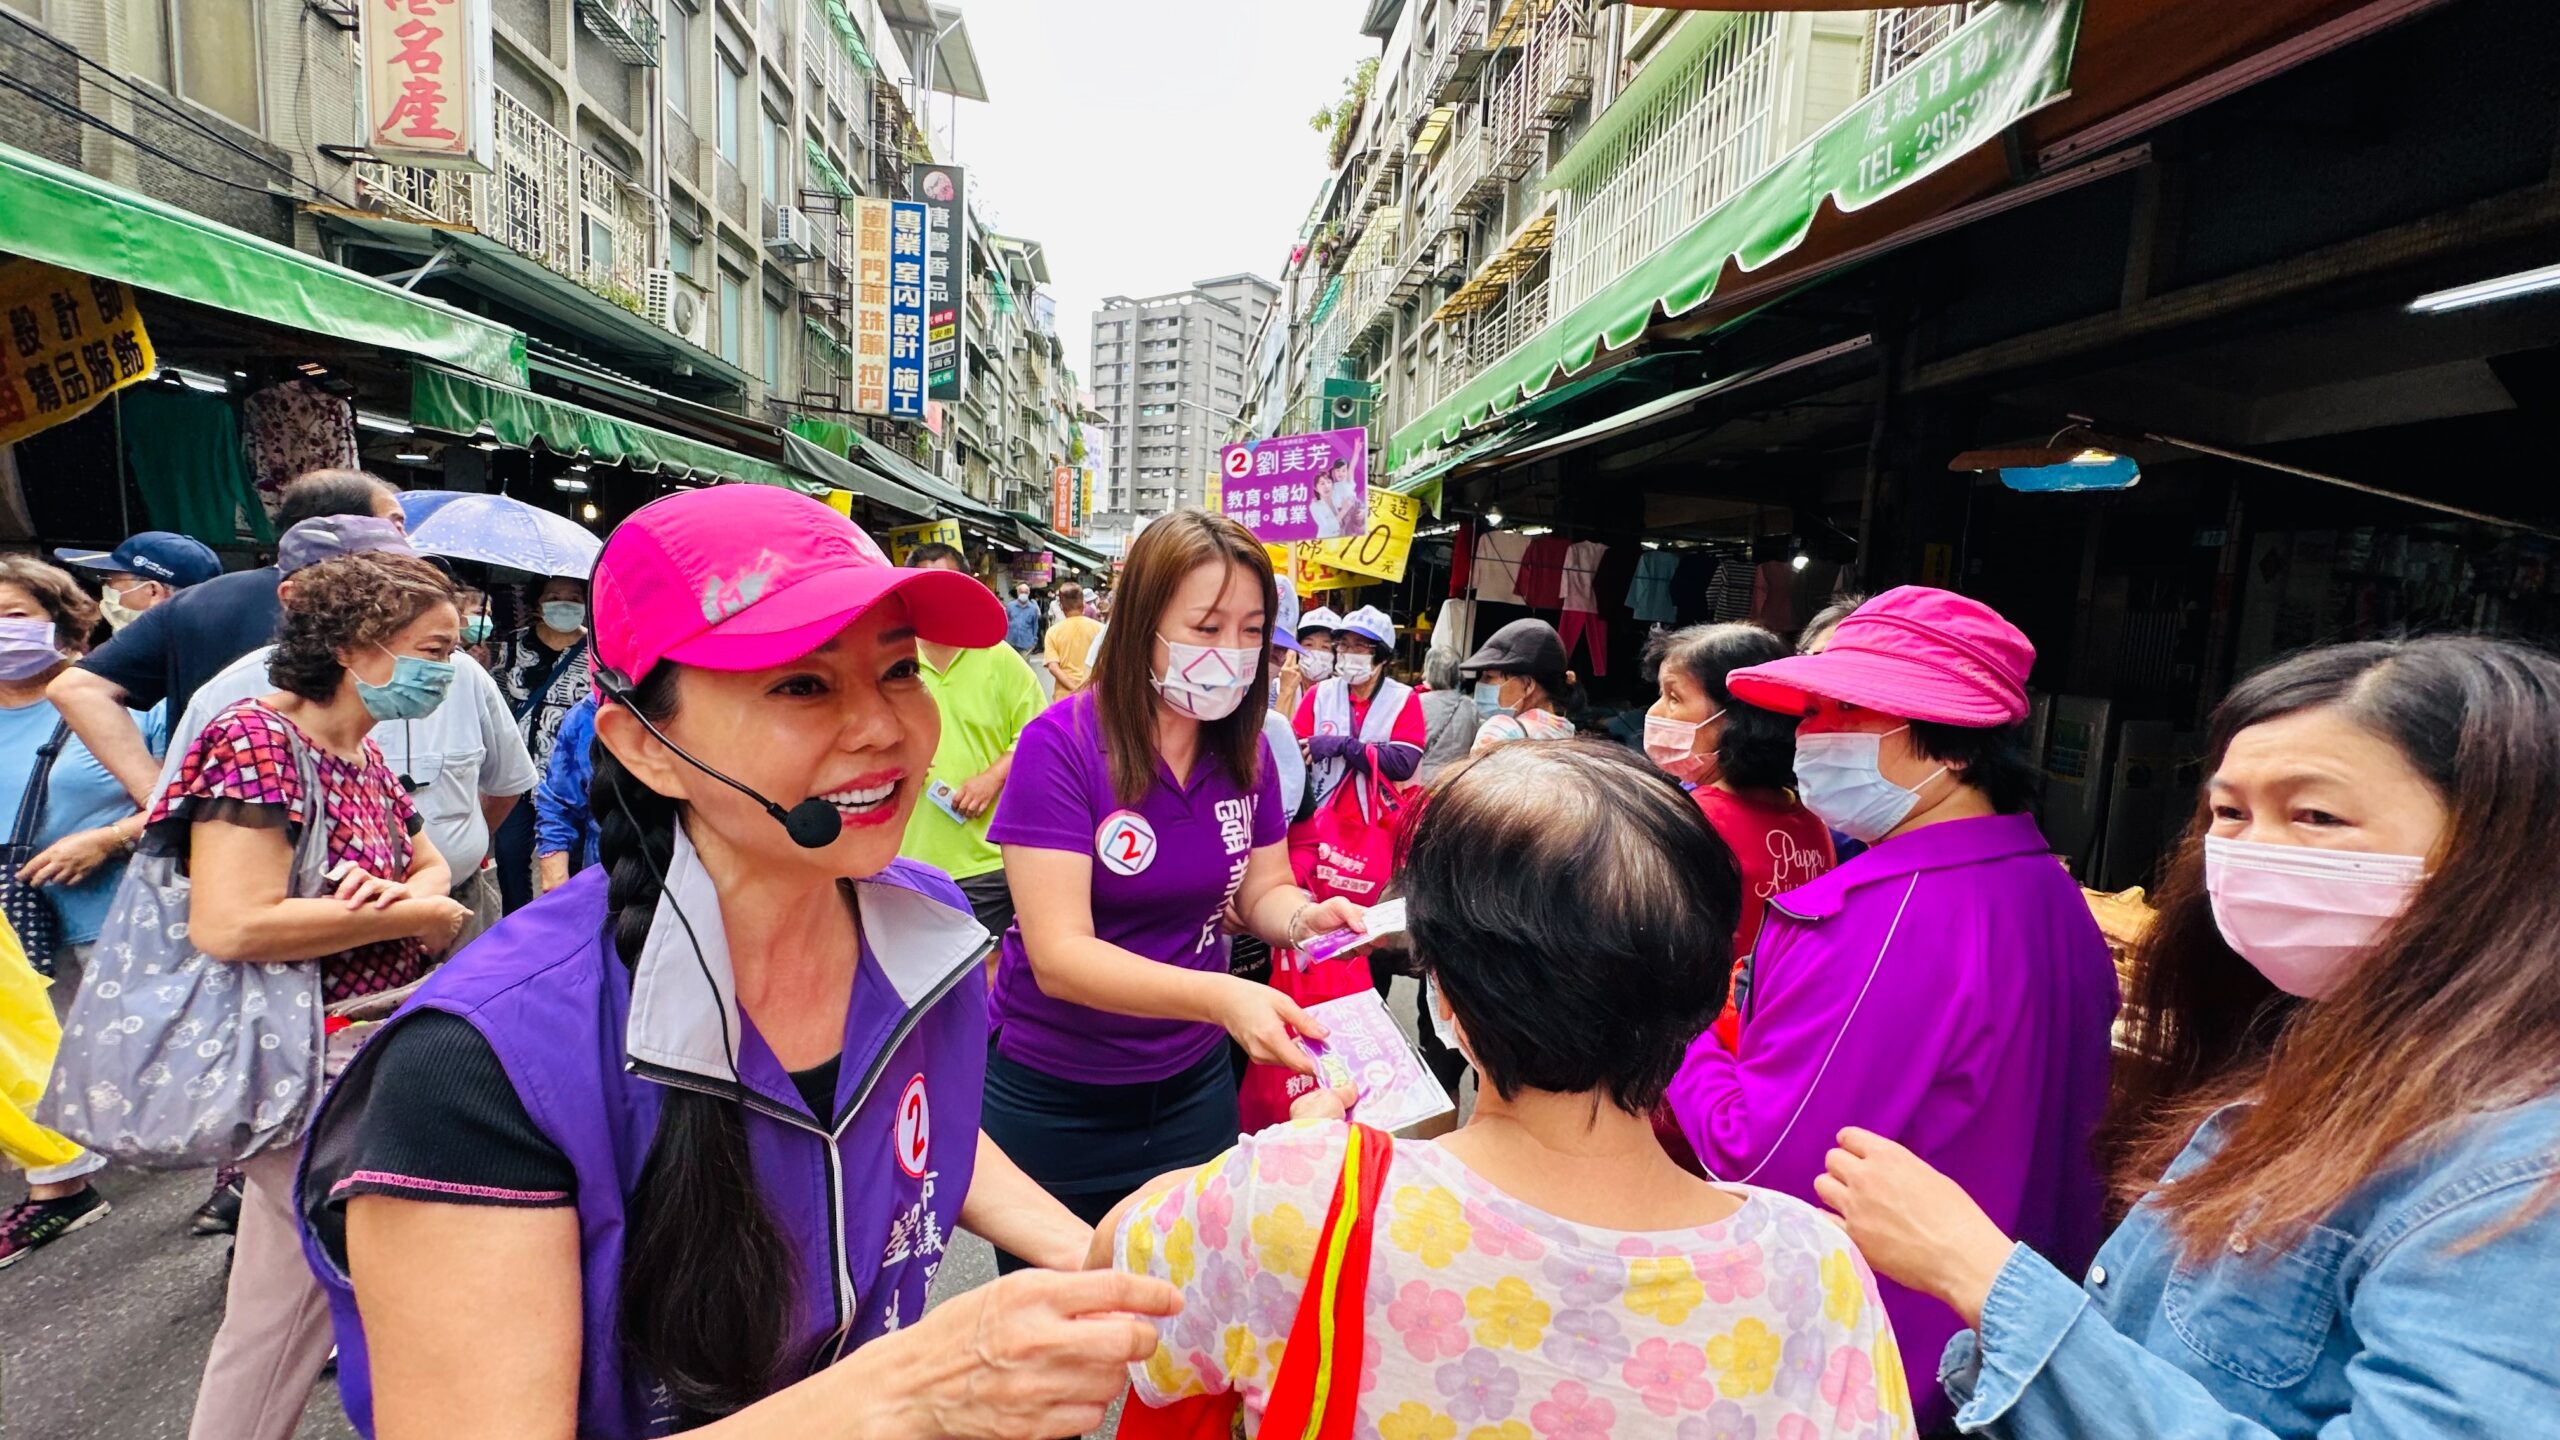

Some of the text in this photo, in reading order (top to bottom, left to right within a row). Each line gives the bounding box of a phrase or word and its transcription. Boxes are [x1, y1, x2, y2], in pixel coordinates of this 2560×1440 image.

[893, 209, 922, 414] 專業室內設計施工
[25, 330, 145, 413] 精品服飾
[1256, 443, 1332, 477] 劉美芳
[1118, 830, 1141, 860] 2
[908, 1092, 925, 1162] 2
